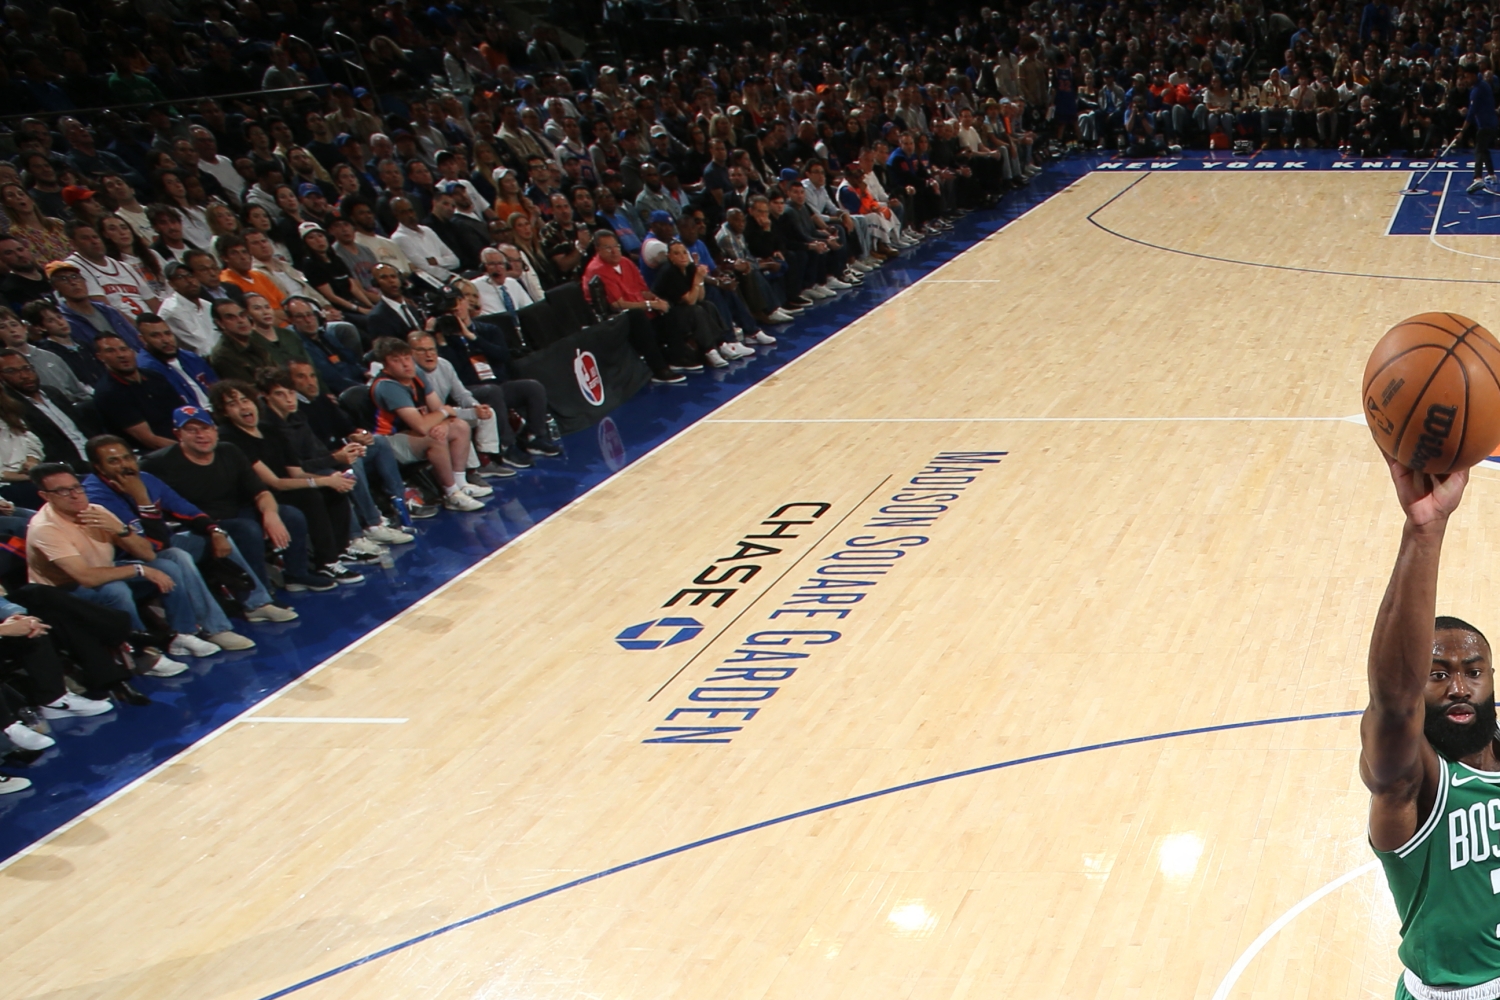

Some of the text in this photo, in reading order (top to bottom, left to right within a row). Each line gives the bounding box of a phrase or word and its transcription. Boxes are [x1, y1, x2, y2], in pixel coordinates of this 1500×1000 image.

[1098, 161, 1180, 170] NEW
[1202, 161, 1309, 170] YORK
[641, 451, 1010, 745] MADISON SQUARE GARDEN
[660, 502, 832, 609] CHASE
